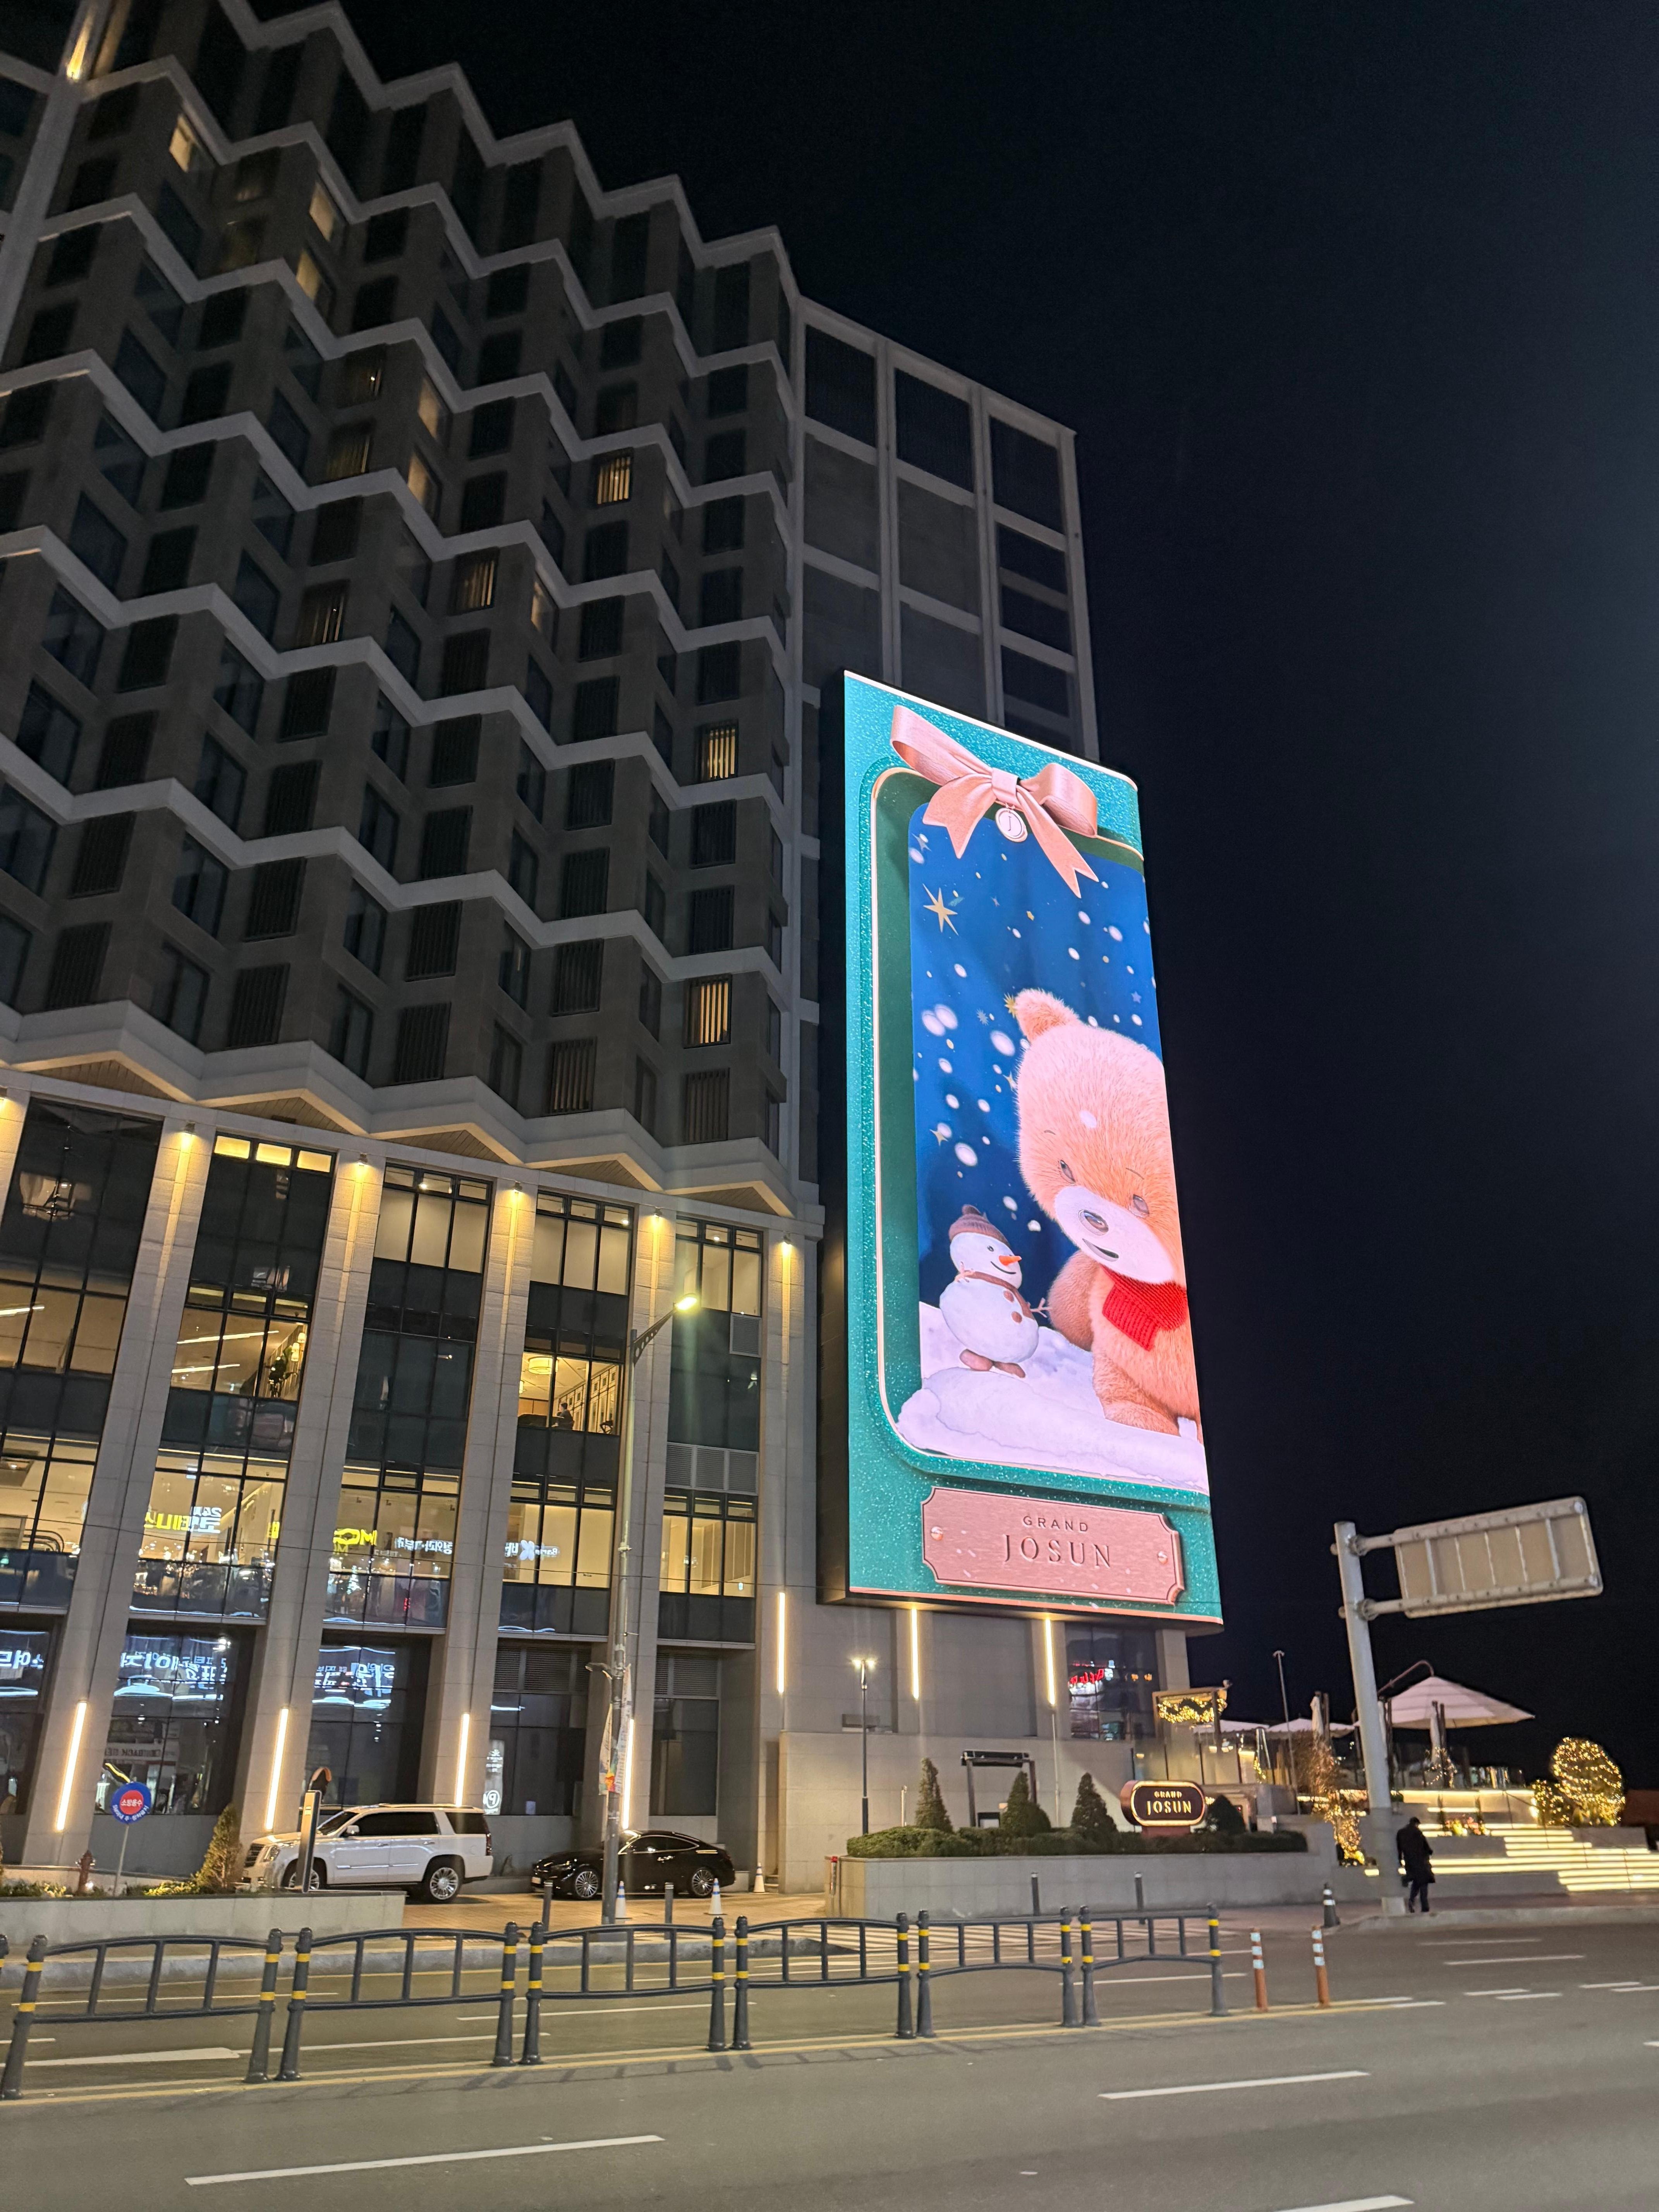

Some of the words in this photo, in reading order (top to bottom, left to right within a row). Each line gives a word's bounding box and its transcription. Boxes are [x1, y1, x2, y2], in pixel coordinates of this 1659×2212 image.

[1008, 816, 1012, 831] J
[1023, 1516, 1089, 1532] GRAND
[1002, 1534, 1111, 1568] JOSUN
[1147, 1801, 1191, 1815] JOSUN
